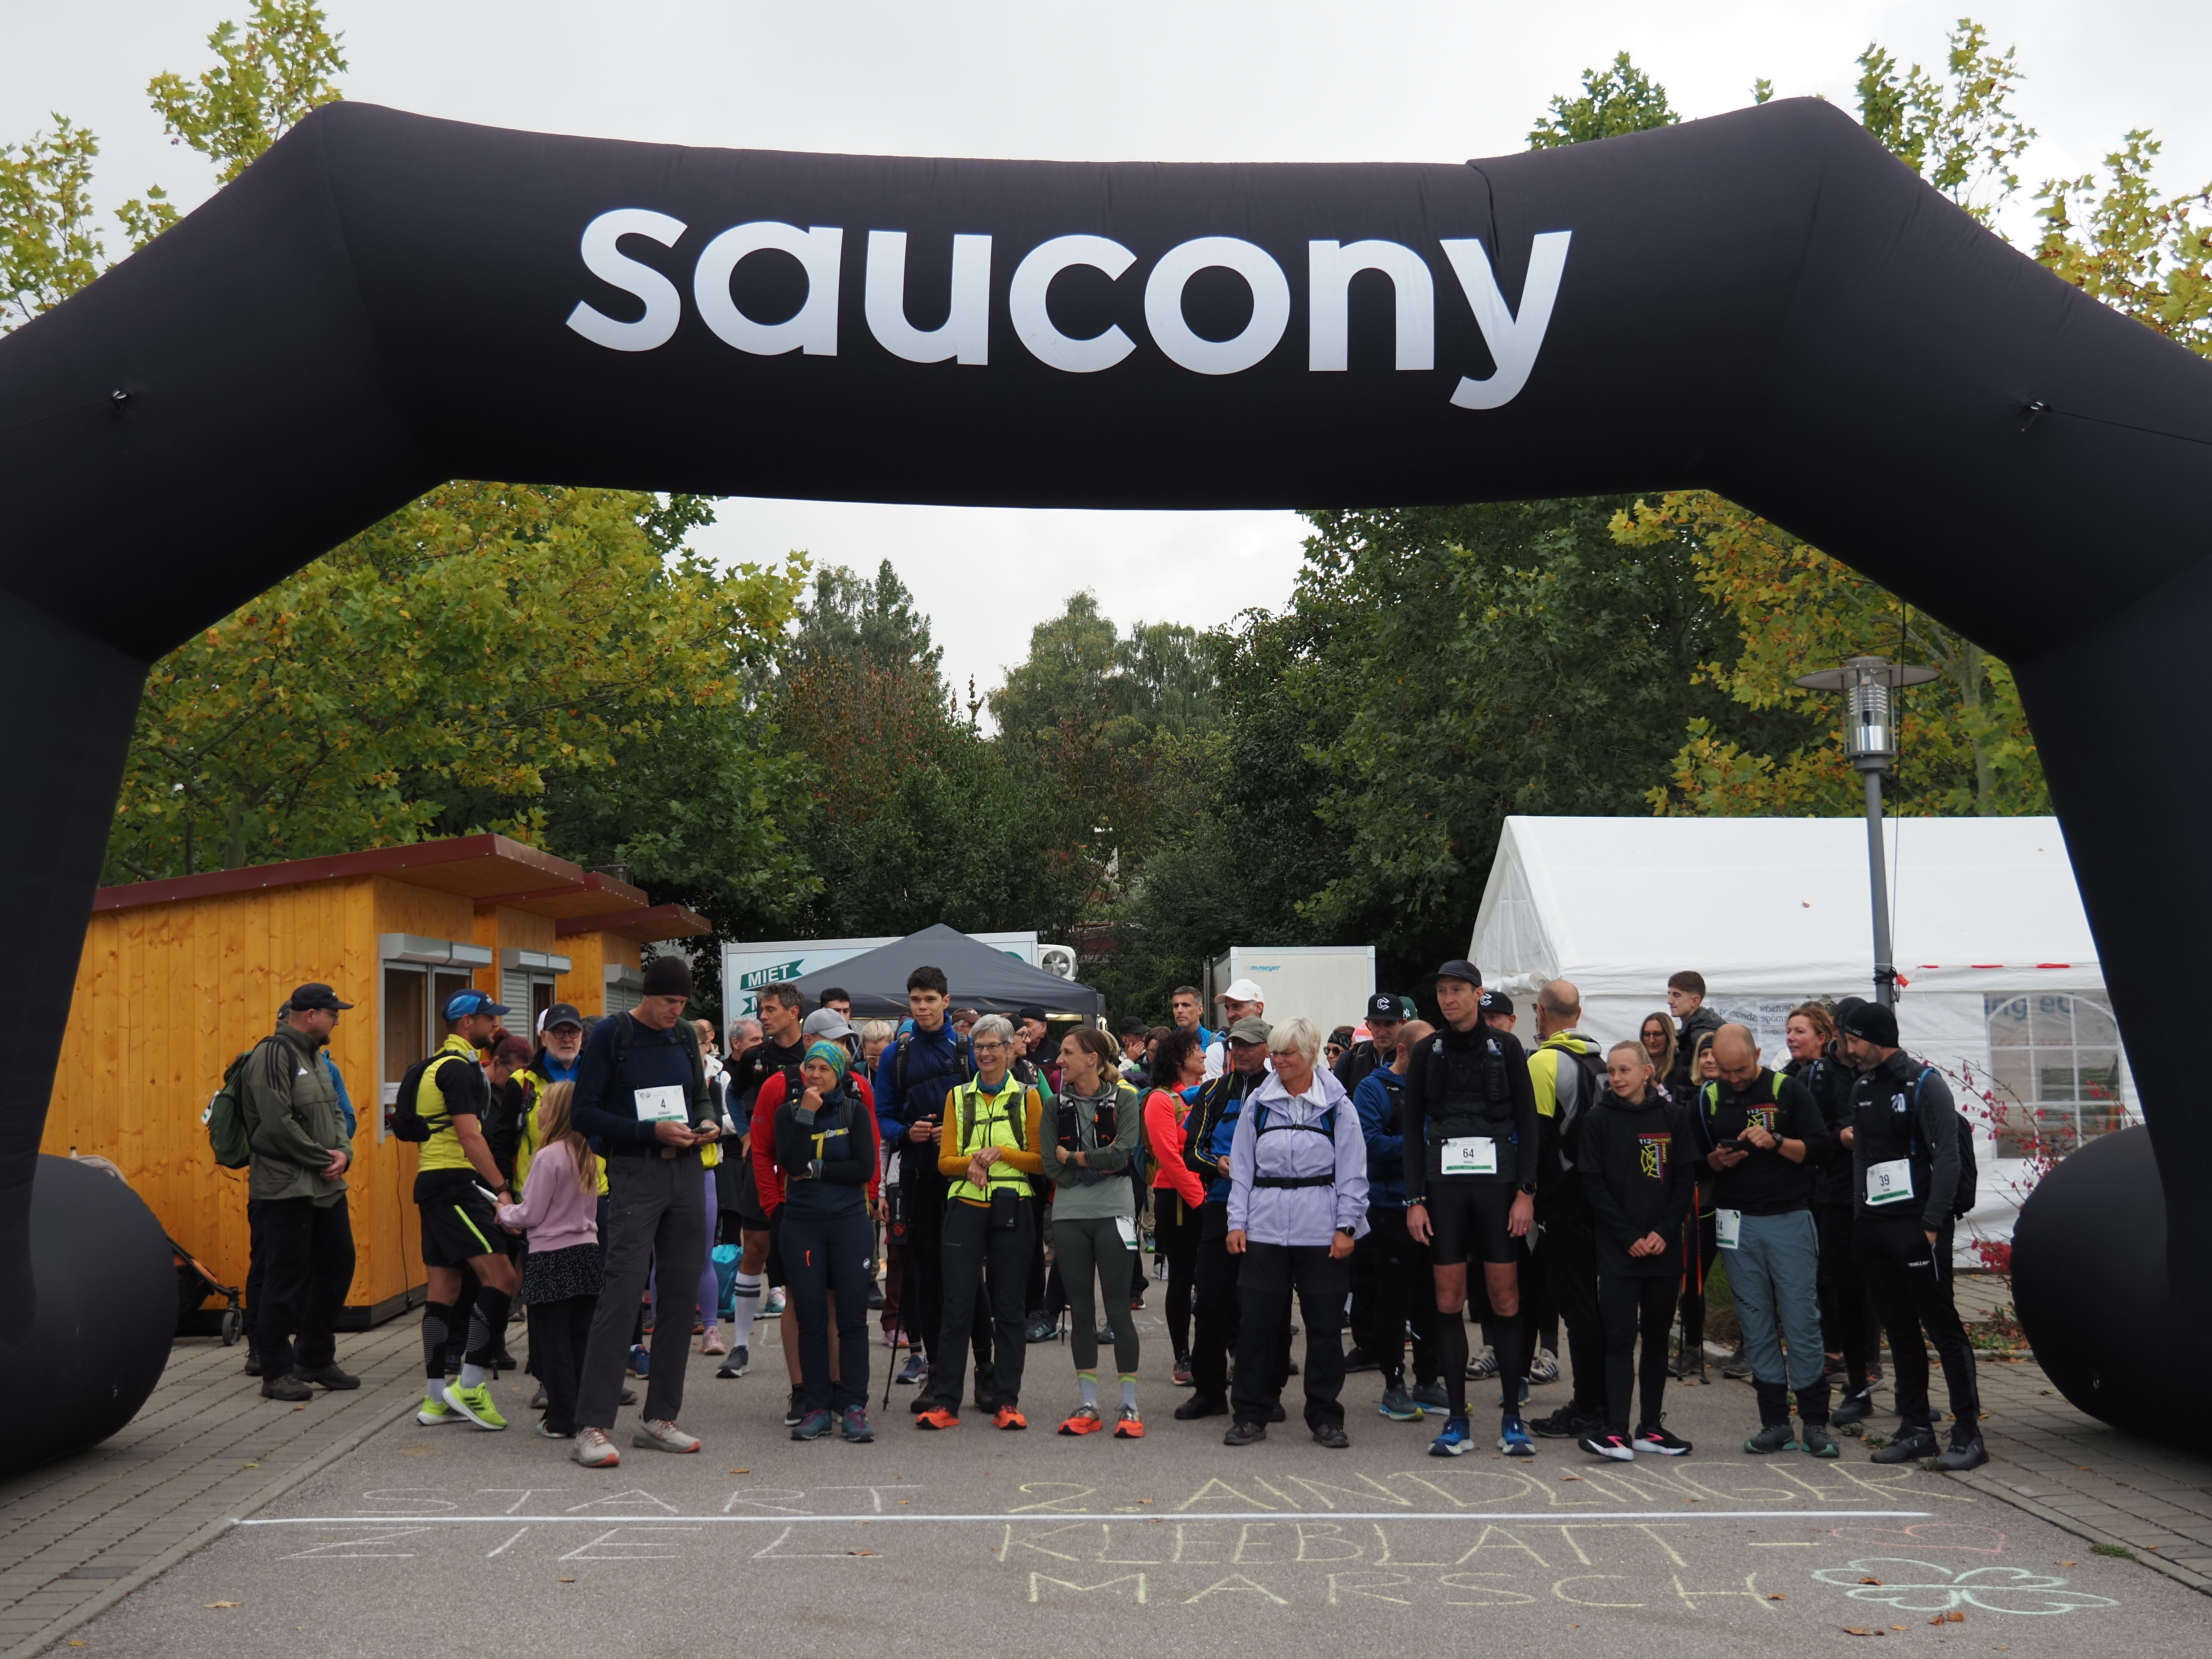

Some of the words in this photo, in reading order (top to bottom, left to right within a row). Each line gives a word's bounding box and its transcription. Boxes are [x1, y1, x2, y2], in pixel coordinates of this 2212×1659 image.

[566, 209, 1572, 409] saucony
[748, 963, 790, 987] MIET
[1984, 993, 2028, 1021] ing
[661, 1098, 666, 1109] 4
[1463, 1148, 1474, 1158] 64
[1879, 1174, 1890, 1186] 39
[357, 1483, 924, 1515] START
[1178, 1462, 1977, 1511] AINDLINGER
[275, 1526, 882, 1560] ZIEL
[1027, 1571, 1778, 1610] MARSCH
